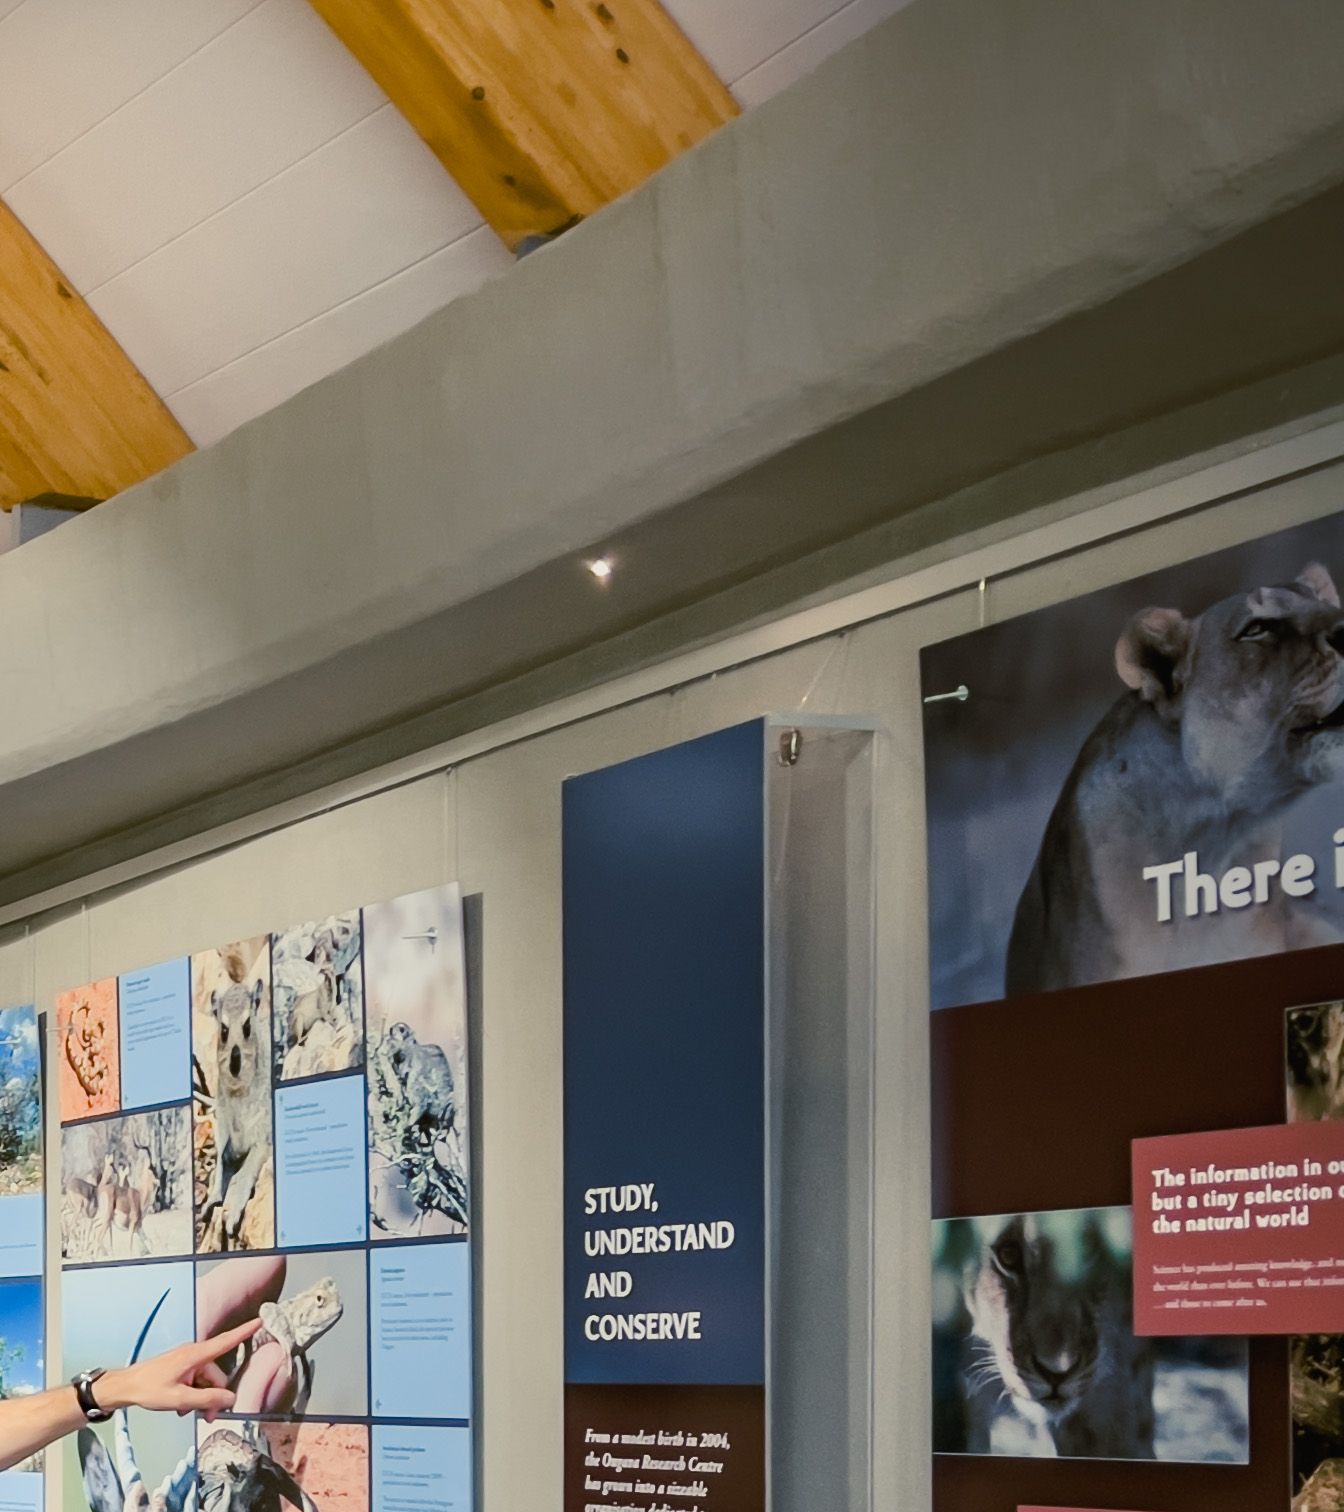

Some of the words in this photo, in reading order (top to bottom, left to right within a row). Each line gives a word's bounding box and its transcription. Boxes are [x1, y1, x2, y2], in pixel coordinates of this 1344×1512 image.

[1143, 850, 1315, 922] There
[1152, 1168, 1185, 1187] The
[1190, 1162, 1298, 1185] information
[1304, 1159, 1322, 1176] in
[584, 1183, 658, 1215] STUDY,
[1152, 1192, 1182, 1211] but
[1187, 1196, 1197, 1208] a
[1203, 1190, 1238, 1211] tiny
[1244, 1184, 1332, 1205] selection
[1152, 1215, 1180, 1233] the
[1186, 1209, 1250, 1231] natural
[1256, 1206, 1309, 1227] world
[584, 1221, 734, 1257] UNDERSTAND
[585, 1271, 633, 1299] AND
[585, 1312, 701, 1341] CONSERVE
[642, 1455, 686, 1471] Research
[688, 1457, 724, 1473] Centre
